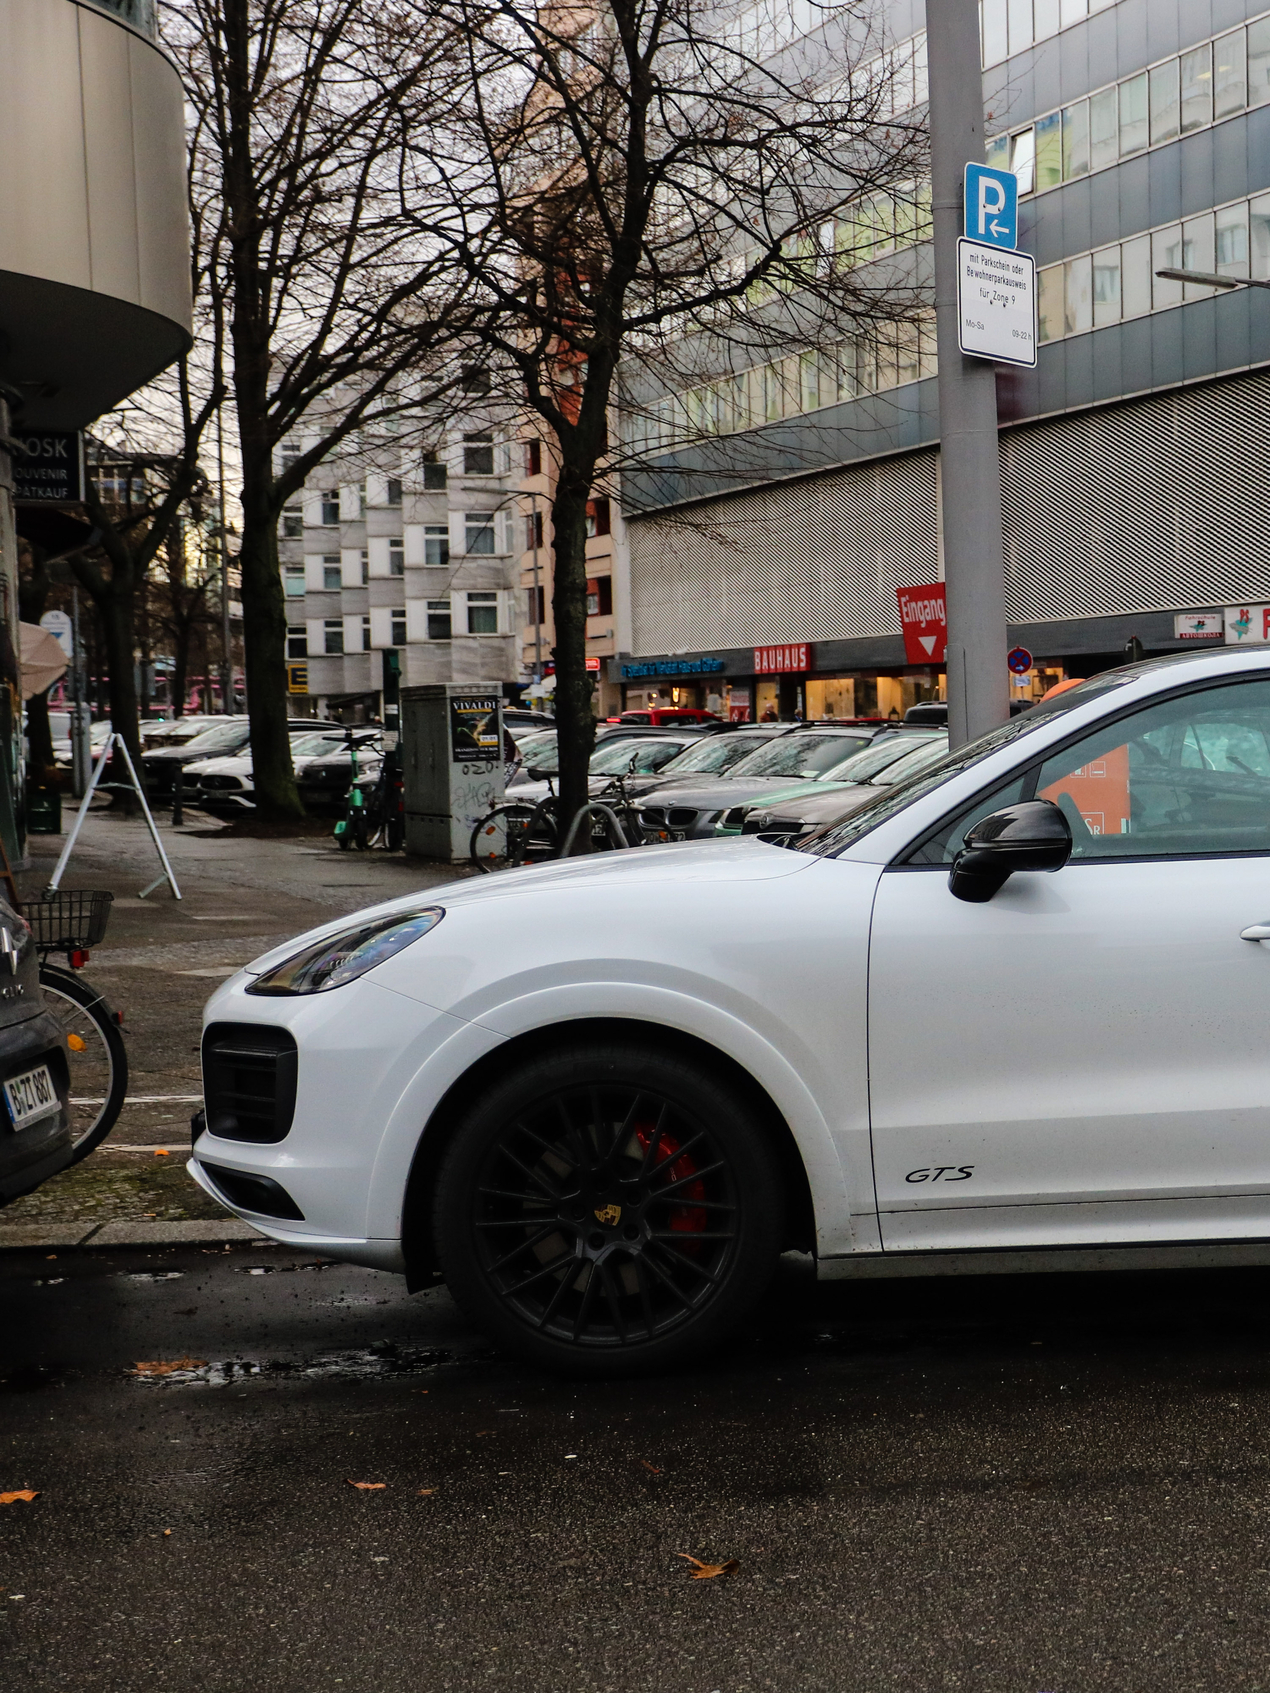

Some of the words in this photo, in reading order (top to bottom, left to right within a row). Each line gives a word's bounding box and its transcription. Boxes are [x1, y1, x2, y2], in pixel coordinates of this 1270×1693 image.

[978, 175, 1006, 235] P
[969, 252, 979, 263] mit
[981, 254, 1010, 272] Parkschein
[1011, 263, 1024, 275] oder
[966, 265, 1027, 290] Bewohnerparkausweis
[979, 287, 990, 298] für
[992, 290, 1009, 304] Zone
[1011, 295, 1016, 305] 9
[965, 318, 985, 331] Mo-Sa
[1011, 329, 1027, 340] 09-22
[15, 467, 68, 480] OUVENIR
[900, 595, 946, 628] Eingang
[754, 648, 807, 670] BAUHAUS
[453, 701, 496, 710] VIVALDI
[9, 1083, 21, 1116] B
[20, 1076, 37, 1111] ZT
[905, 1165, 975, 1183] GTS
